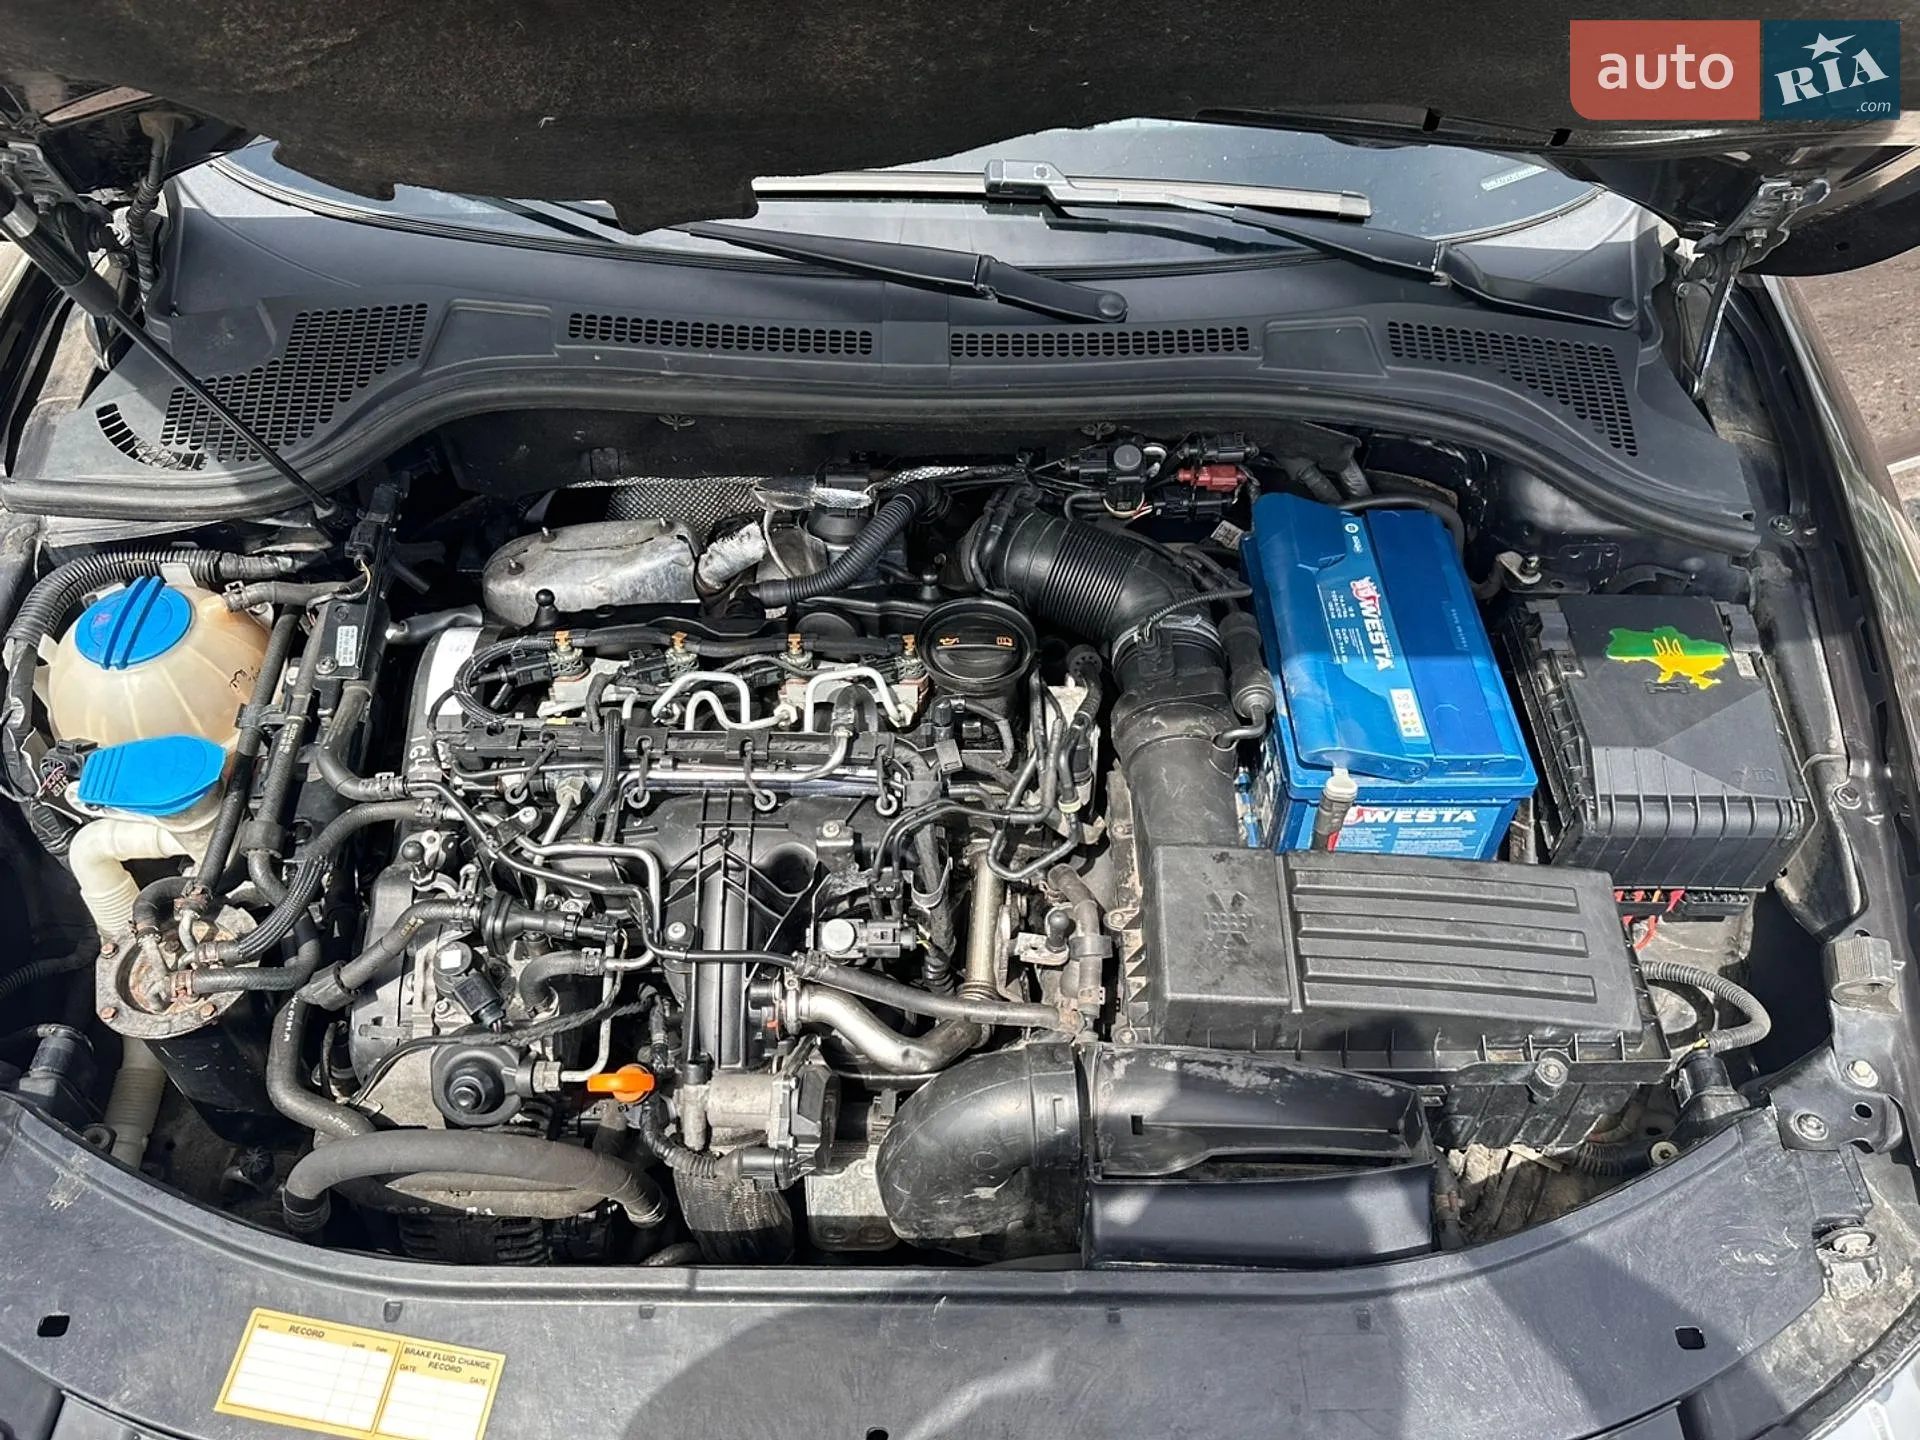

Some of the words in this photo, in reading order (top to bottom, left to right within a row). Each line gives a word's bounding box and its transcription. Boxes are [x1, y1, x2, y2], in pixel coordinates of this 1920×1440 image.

[1359, 597, 1393, 671] WESTA
[1362, 809, 1477, 824] WESTA
[288, 1325, 325, 1338] RECORD
[404, 1346, 431, 1359] BRAKE
[432, 1351, 456, 1363] FLUID
[458, 1357, 491, 1369] CHANGE
[399, 1363, 416, 1373] DATE
[427, 1361, 462, 1374] RECORD
[470, 1377, 487, 1385] DATE
